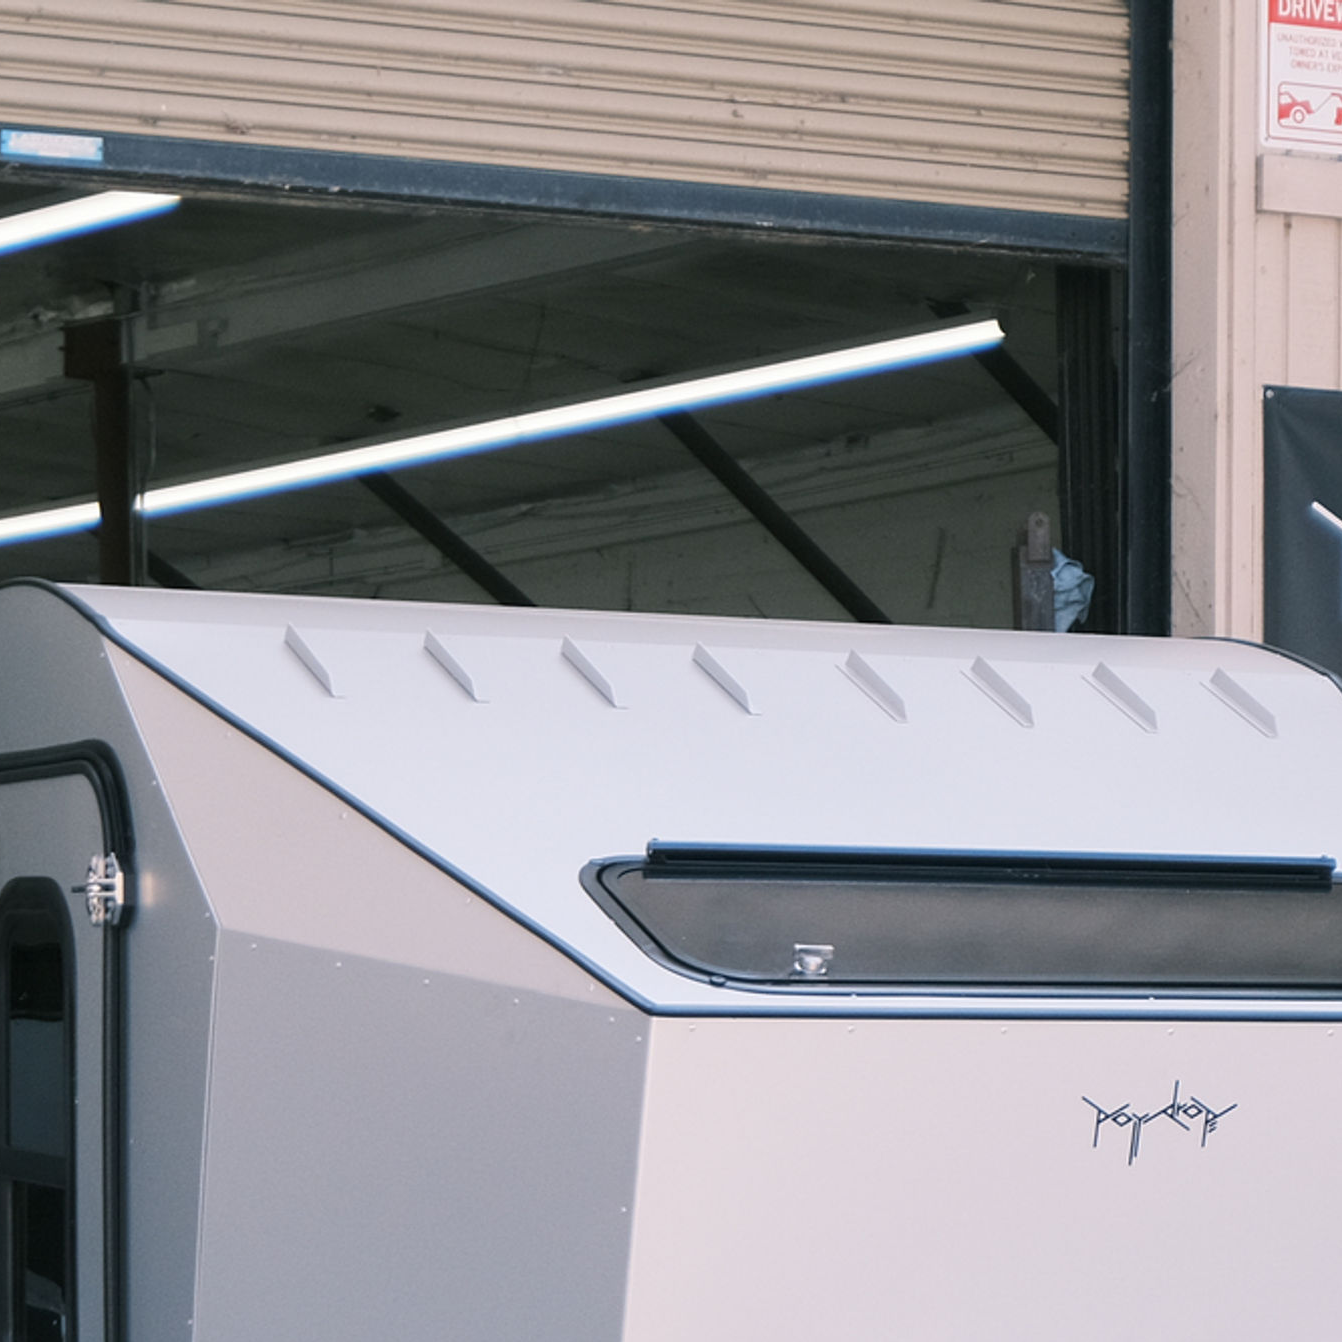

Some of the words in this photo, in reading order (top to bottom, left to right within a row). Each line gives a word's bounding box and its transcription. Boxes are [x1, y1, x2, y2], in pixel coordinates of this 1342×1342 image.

[1276, 33, 1337, 47] UNAUTHORIZED
[1289, 46, 1316, 58] TOWED
[1318, 49, 1329, 59] AT
